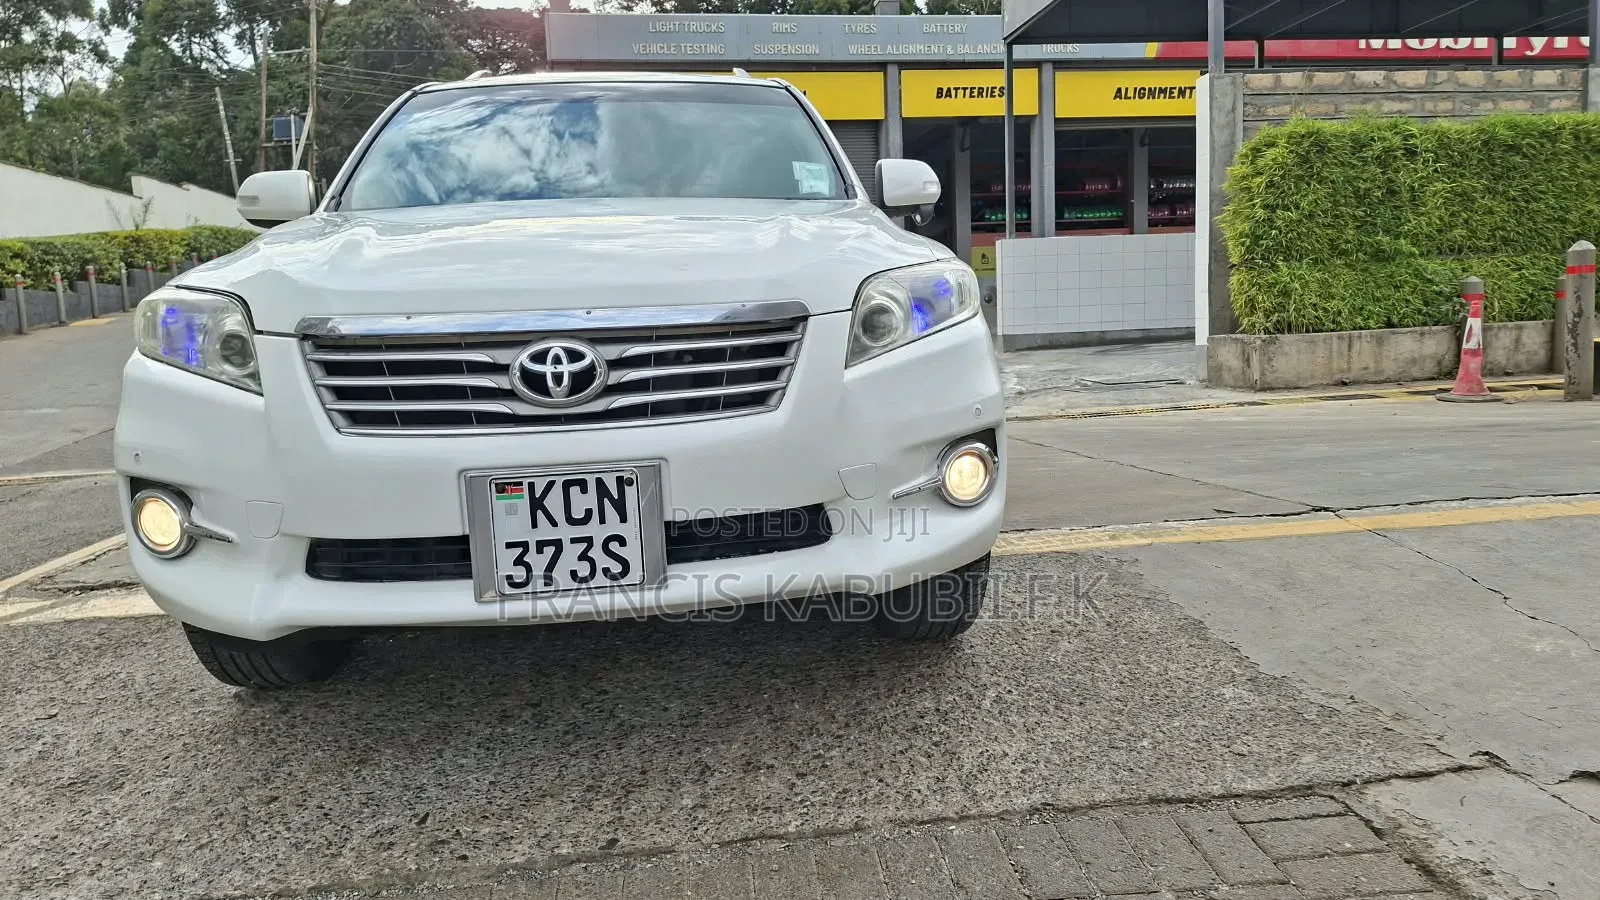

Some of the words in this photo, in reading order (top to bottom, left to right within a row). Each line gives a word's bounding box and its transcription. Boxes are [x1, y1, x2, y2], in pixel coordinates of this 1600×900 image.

[649, 21, 680, 33] LIGHT
[684, 21, 725, 33] TRUCKS
[772, 22, 797, 33] RIMS
[844, 23, 877, 34] TYRES
[923, 23, 968, 34] BATTERY
[632, 43, 677, 54] VEHICLE
[680, 43, 725, 54] TESTING
[754, 44, 819, 55] SUSPENSION
[848, 44, 883, 55] WHEEL
[886, 44, 945, 55] ALIGNMENT
[946, 44, 953, 55] &
[957, 43, 1006, 54] BALANCIN
[1041, 43, 1080, 53] TRUCKS
[935, 86, 1006, 99] BATTERIES
[1113, 86, 1196, 100] ALIGNMENT
[527, 475, 628, 530] KCN
[504, 533, 631, 589] 373S
